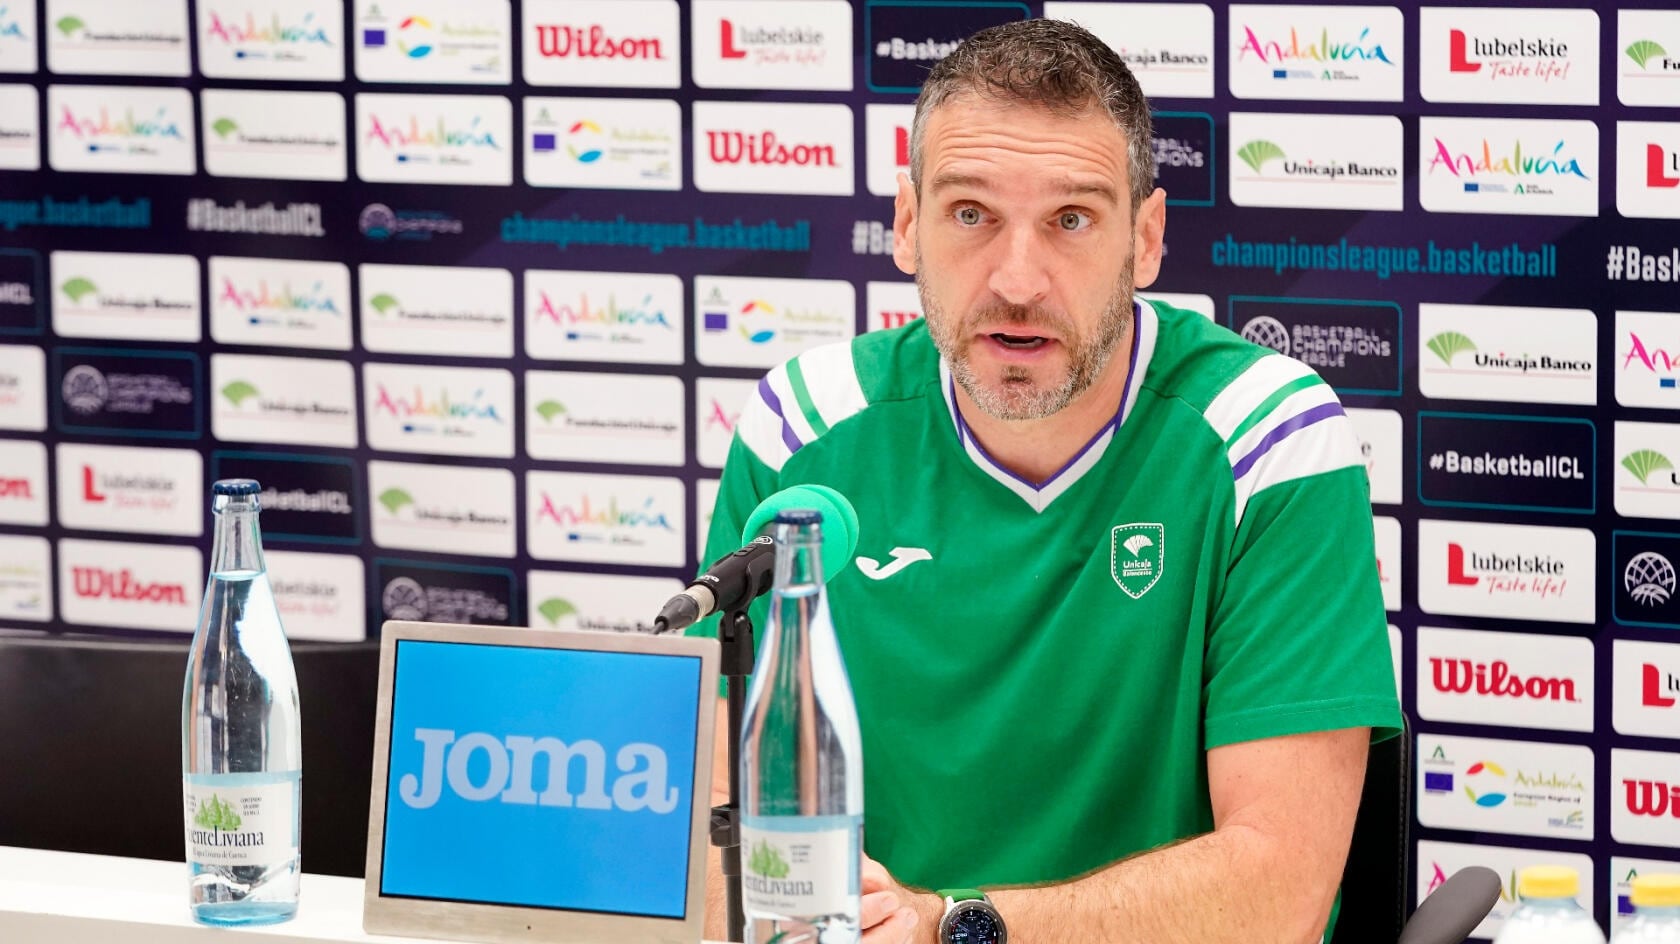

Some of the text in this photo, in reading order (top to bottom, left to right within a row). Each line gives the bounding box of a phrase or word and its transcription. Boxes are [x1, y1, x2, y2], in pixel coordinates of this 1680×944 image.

[536, 25, 664, 59] Wilson
[1161, 51, 1208, 65] Banco
[1238, 25, 1395, 66] Andalucía
[1475, 38, 1568, 57] lubelskie
[1489, 62, 1570, 82] Taste life!
[706, 131, 836, 166] Wilson
[1427, 137, 1592, 182] Andalucía
[1284, 159, 1398, 180] Unicaja Banco
[1212, 234, 1557, 279] championsleague.basketball
[535, 289, 674, 330] Andalucía
[1475, 351, 1593, 373] Unicaja Banco
[1429, 451, 1585, 480] #BasketballCL
[537, 489, 677, 533] Andalucía
[1123, 559, 1152, 569] Unicaja
[1473, 552, 1565, 576] lubelskie
[72, 566, 187, 606] Wilson
[1486, 577, 1567, 599] Taste life!
[1429, 657, 1578, 703] Wilson
[399, 728, 680, 814] Joma
